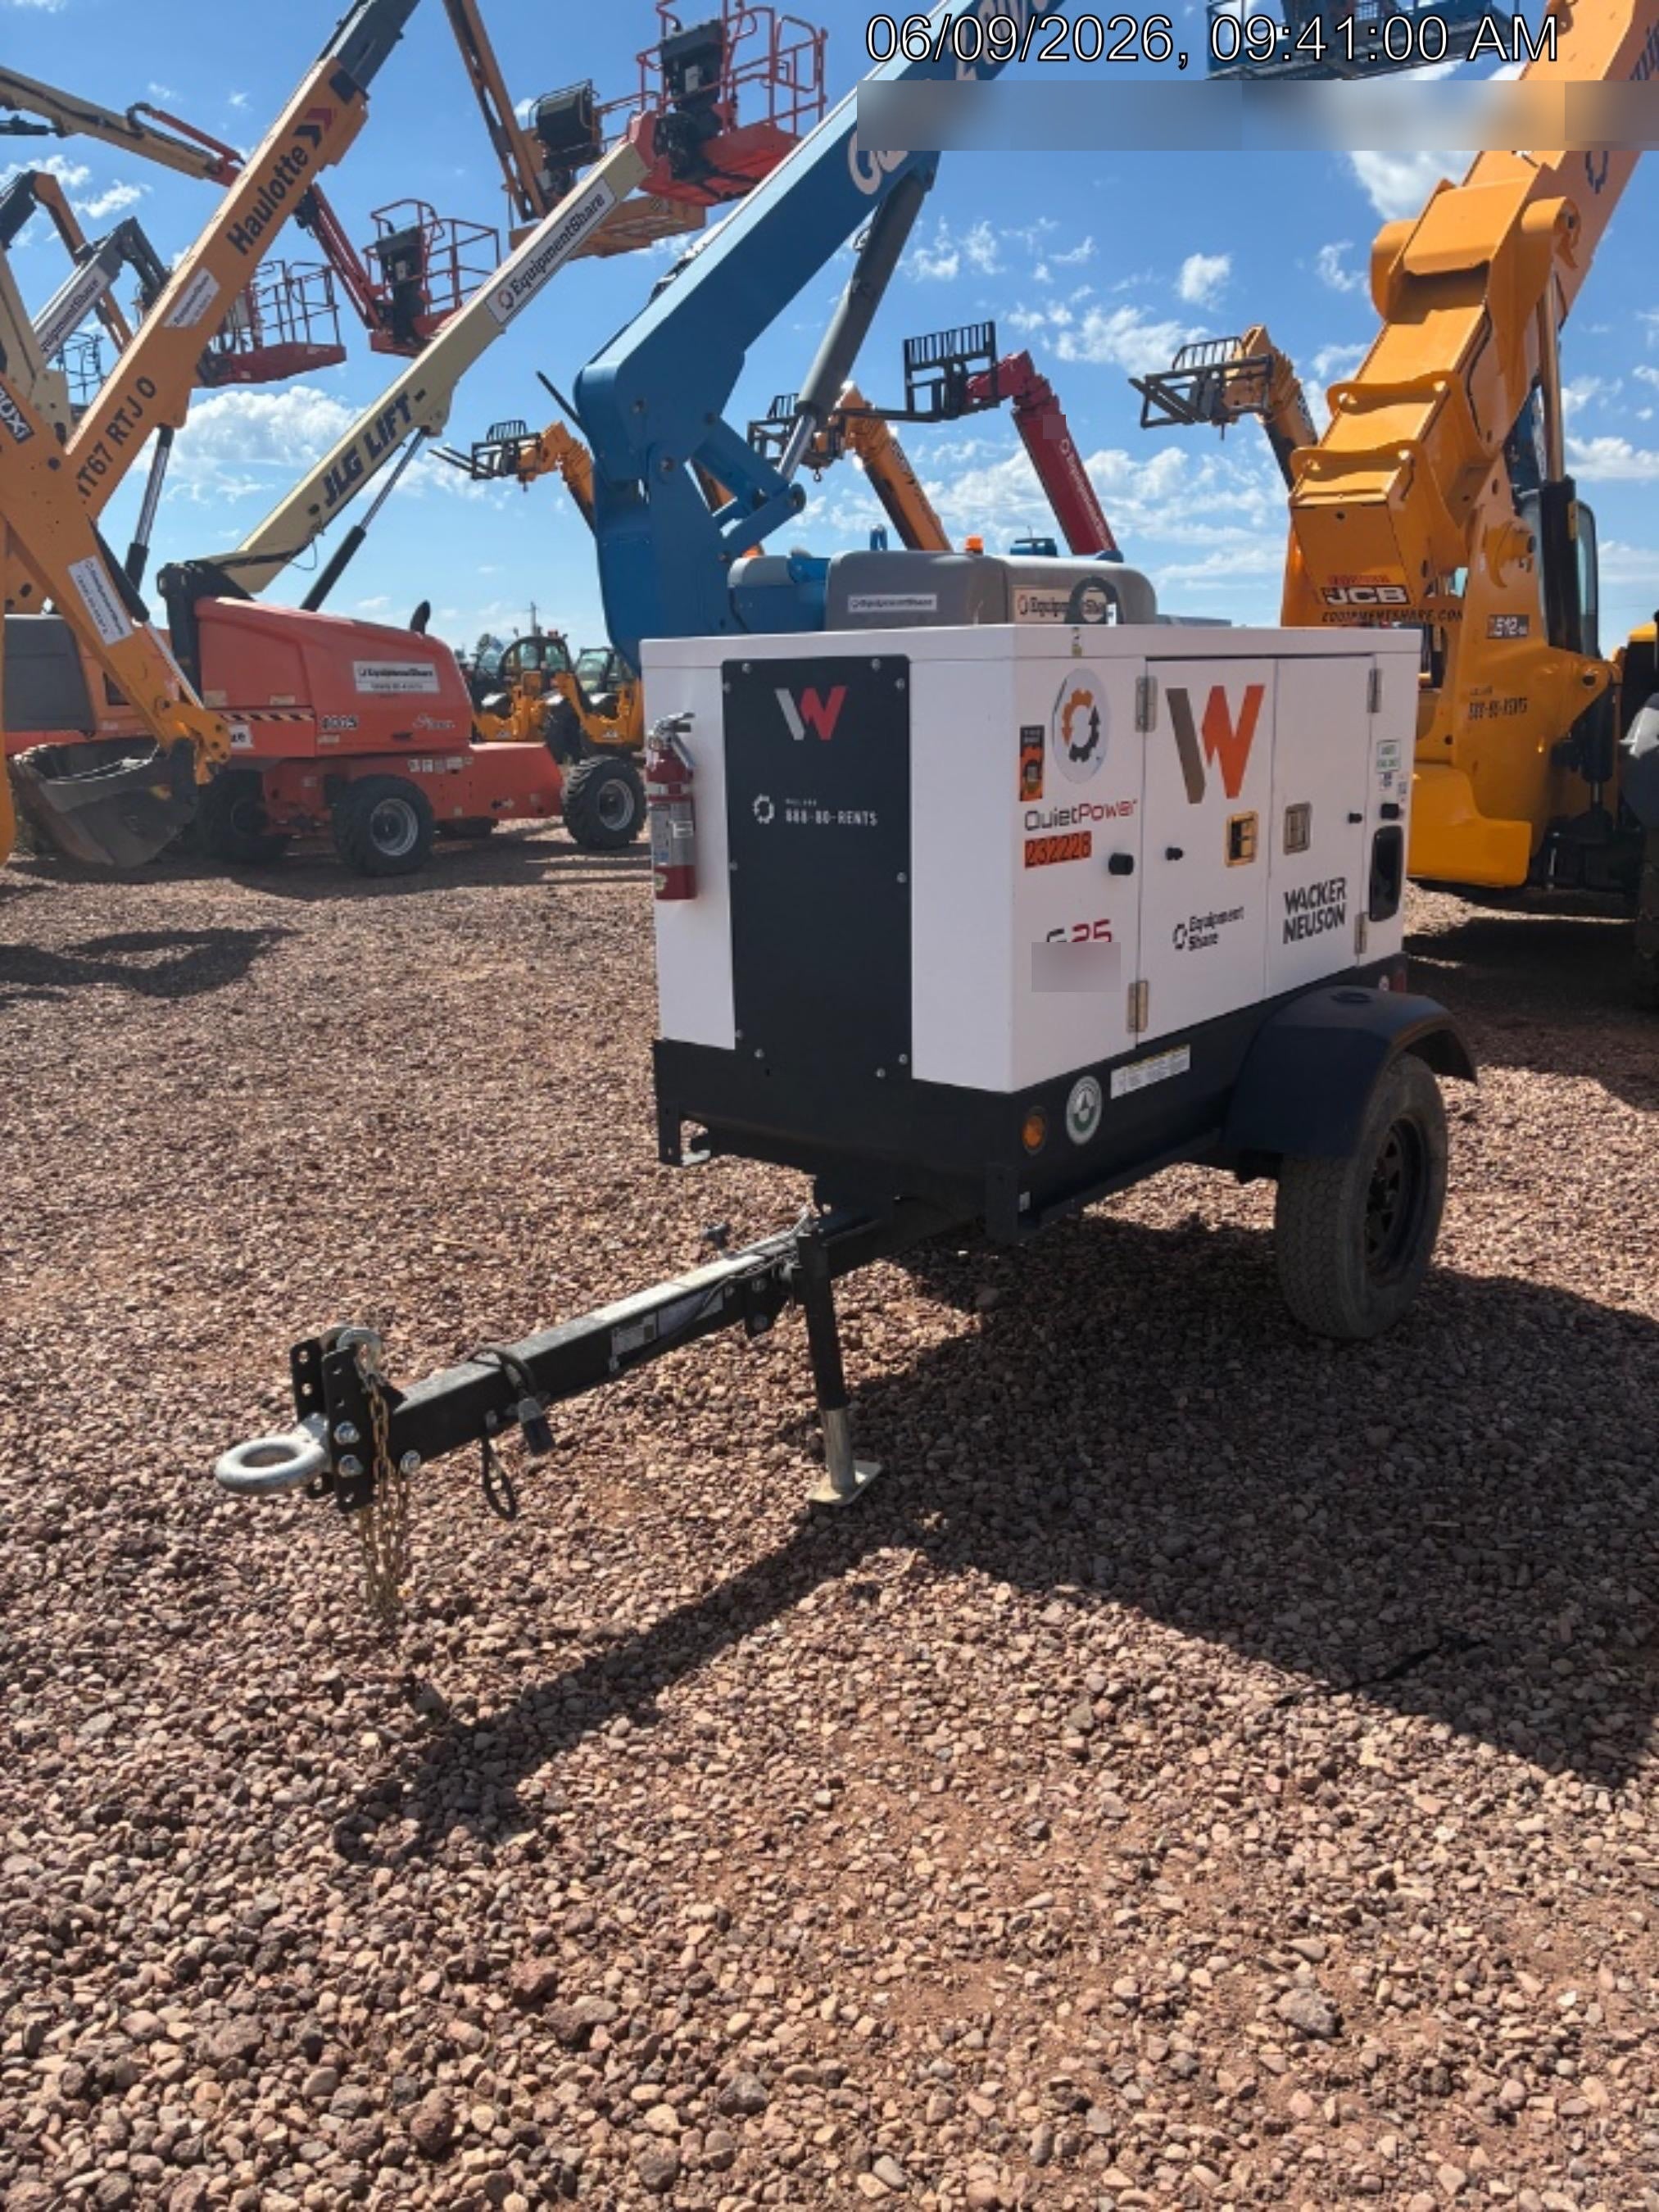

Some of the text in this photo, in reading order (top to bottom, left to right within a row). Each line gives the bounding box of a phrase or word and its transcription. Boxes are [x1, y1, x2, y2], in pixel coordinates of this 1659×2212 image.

[226, 146, 308, 256] Haulotte
[510, 193, 605, 296] EquipmentShare
[42, 279, 99, 353] quipmentShare
[106, 395, 143, 446] RTJ
[323, 391, 412, 507] JLG LIFT
[1327, 587, 1407, 604] JCB
[1024, 801, 1133, 831] QuietPower
[1025, 833, 1092, 868] 232228
[1284, 877, 1346, 915] WACKER
[1190, 906, 1244, 932] Equipment
[1283, 902, 1345, 944] NEUSON
[1190, 932, 1218, 951] Share
